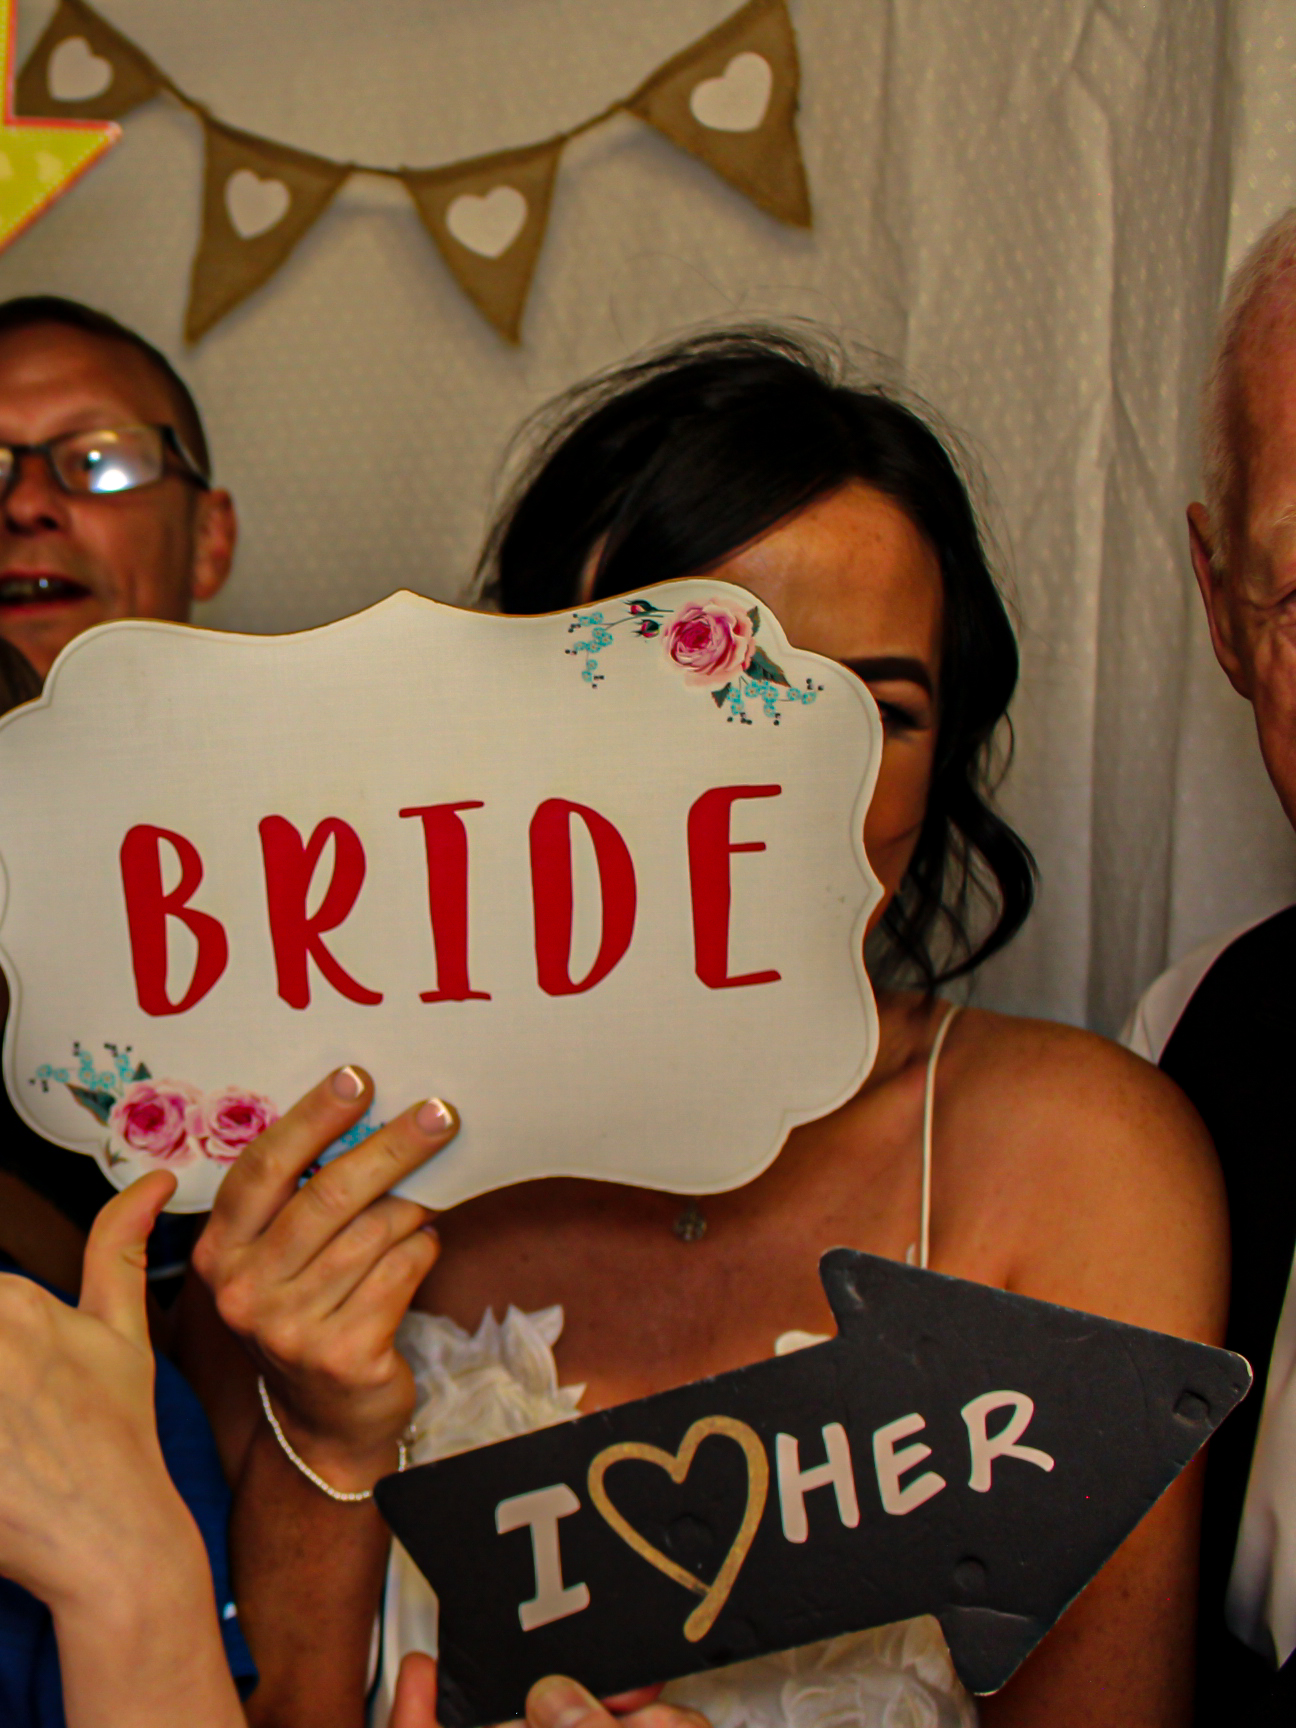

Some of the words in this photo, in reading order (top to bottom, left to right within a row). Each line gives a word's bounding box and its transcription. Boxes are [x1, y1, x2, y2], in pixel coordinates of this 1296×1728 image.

[119, 783, 783, 1018] BRIDE
[494, 1482, 591, 1632] I
[775, 1389, 1055, 1544] HER
